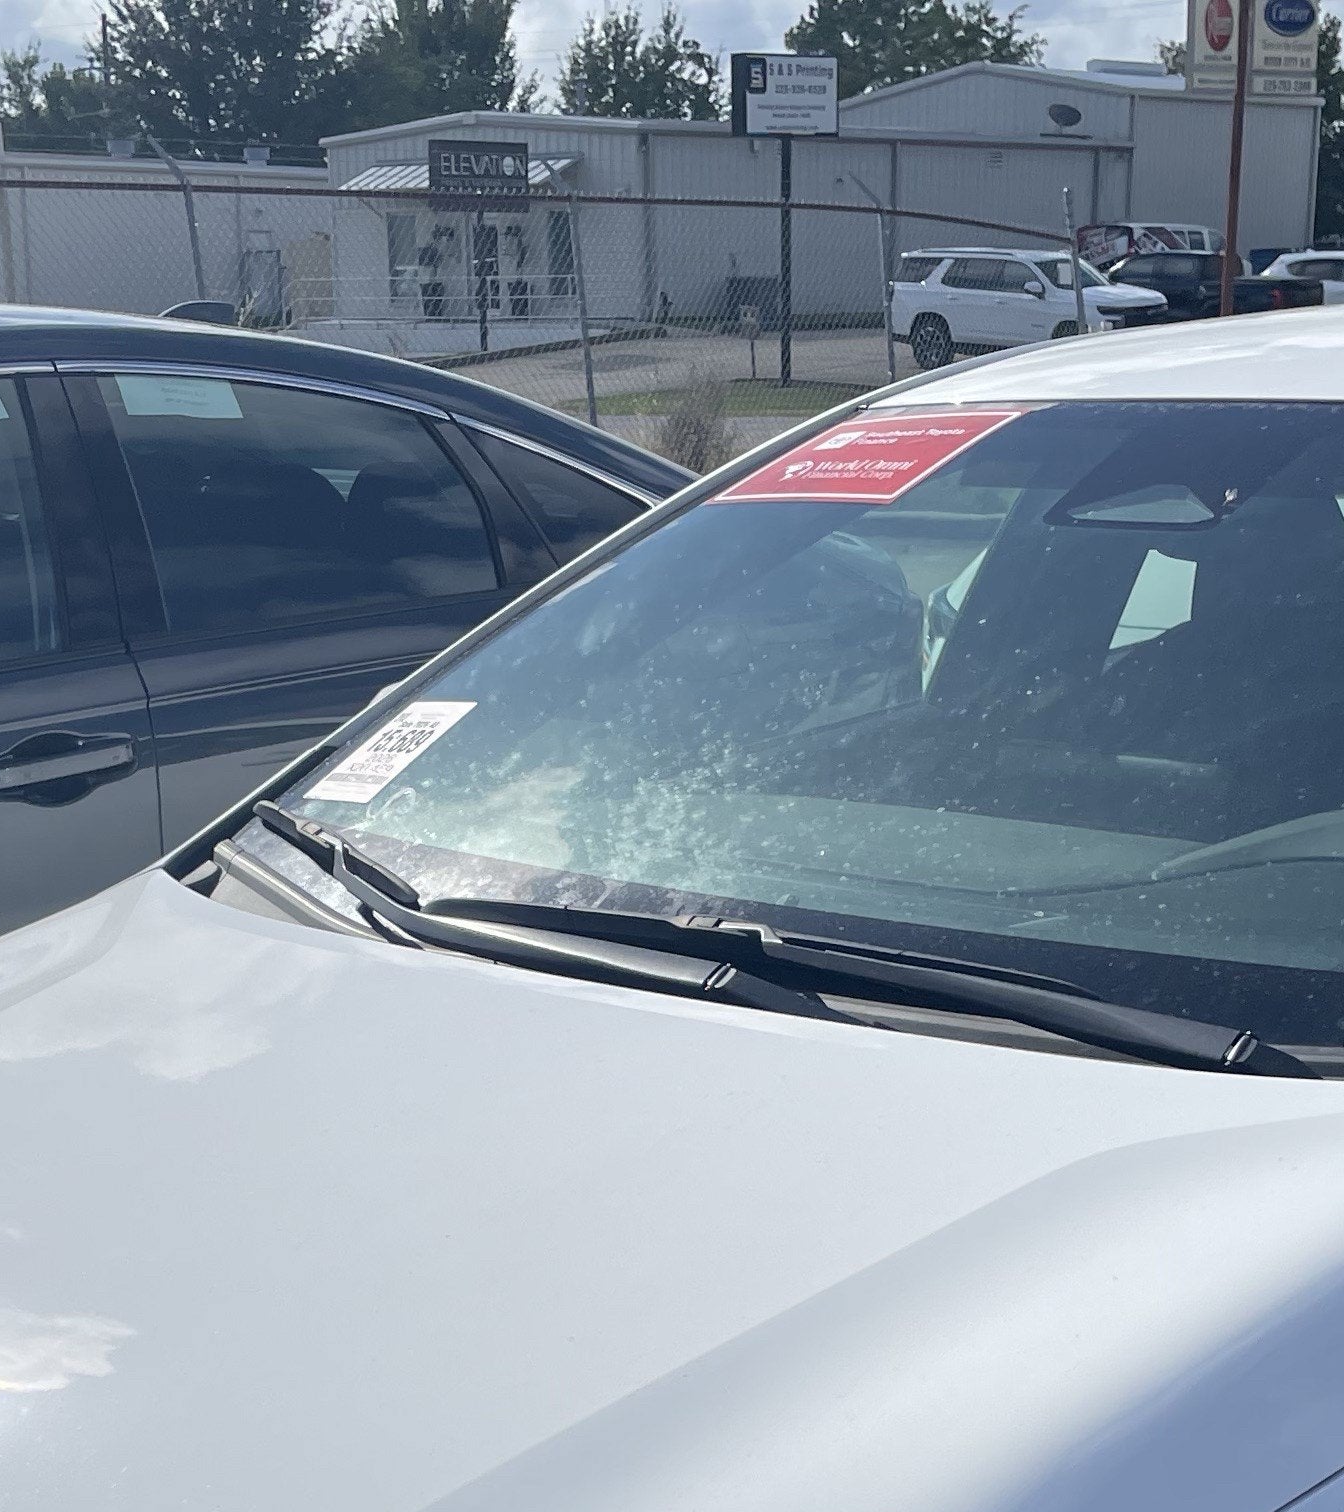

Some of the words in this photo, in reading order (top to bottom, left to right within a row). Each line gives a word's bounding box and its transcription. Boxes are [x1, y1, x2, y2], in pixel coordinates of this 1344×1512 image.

[769, 63, 775, 76] S
[787, 63, 793, 76] S
[796, 64, 834, 79] Printing
[440, 153, 527, 176] ELEVATION
[814, 459, 865, 471] World
